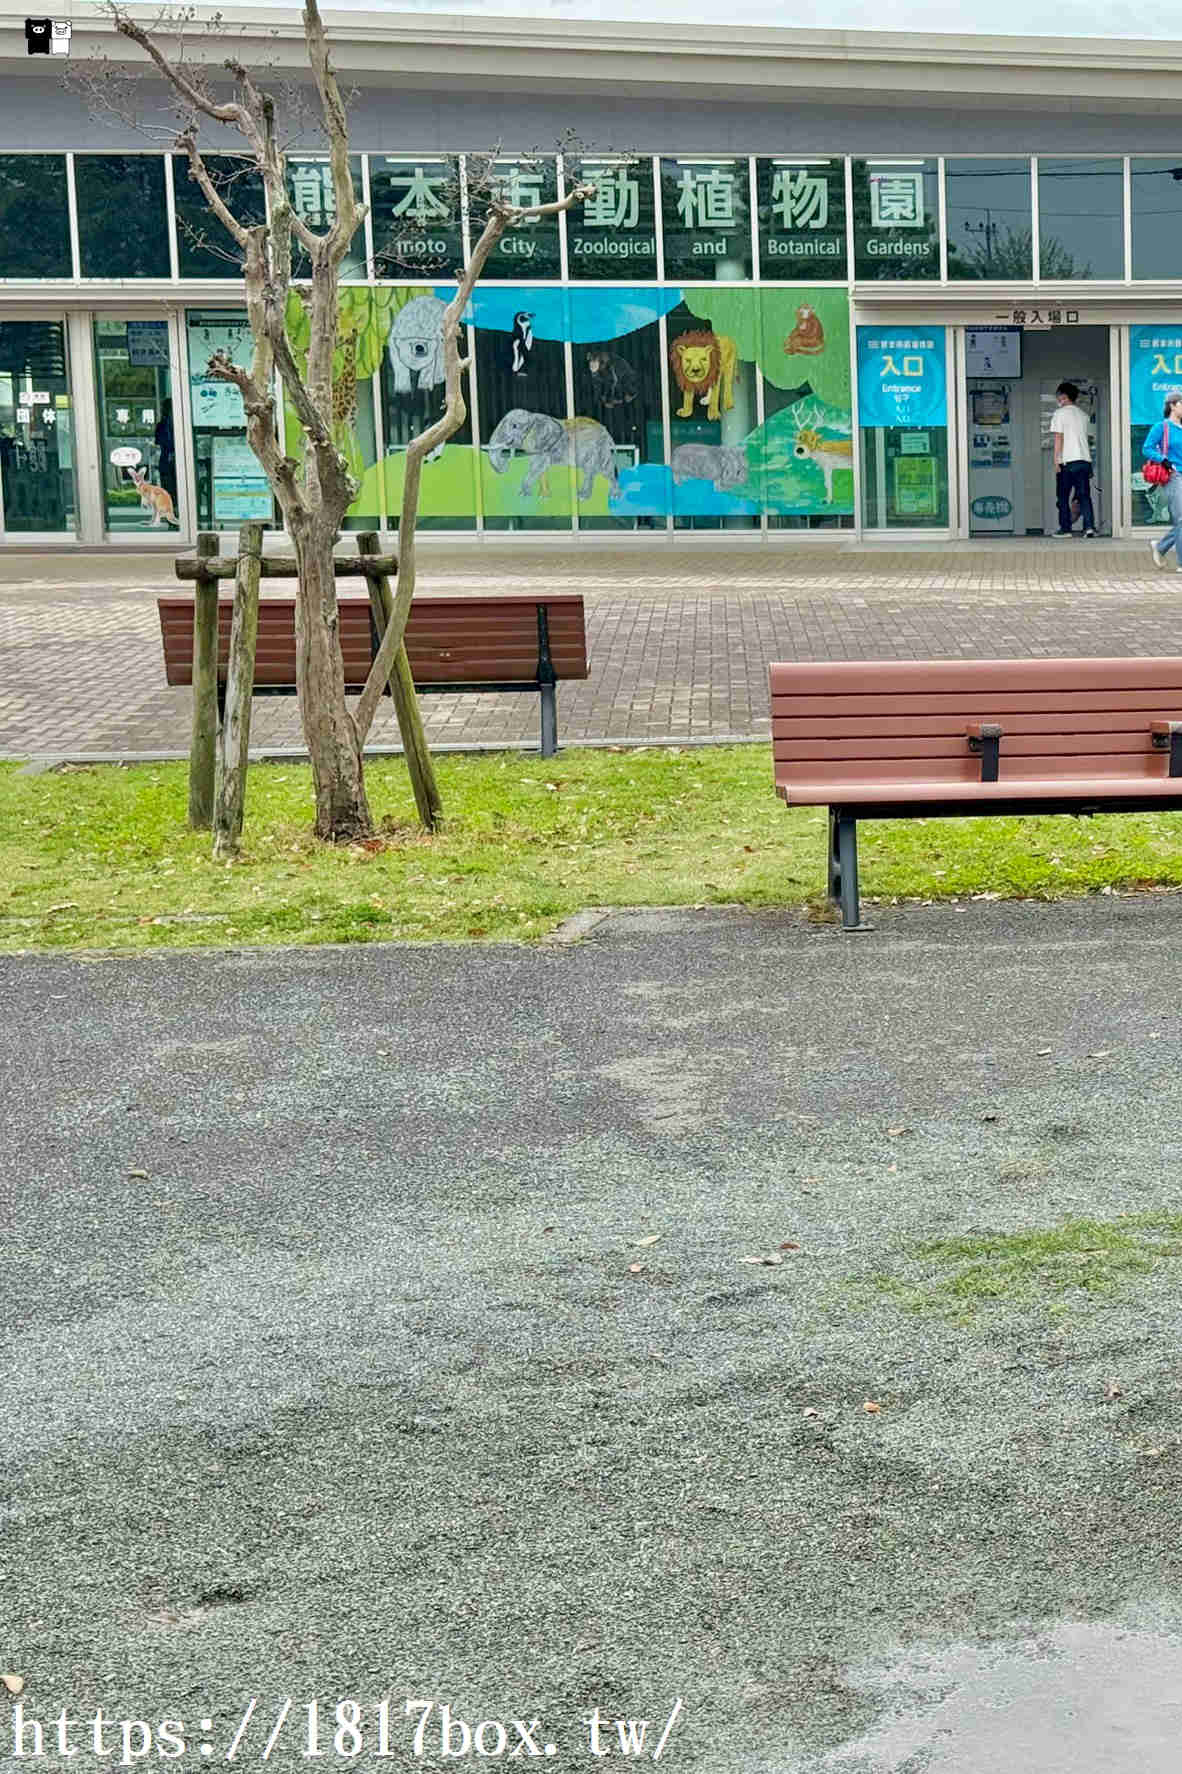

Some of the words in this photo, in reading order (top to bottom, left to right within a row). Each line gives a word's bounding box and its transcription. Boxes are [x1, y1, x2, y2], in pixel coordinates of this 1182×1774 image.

[500, 237, 536, 257] City
[574, 237, 656, 258] Zoological
[692, 238, 727, 255] and
[768, 239, 841, 255] Botanical
[867, 239, 930, 256] Gardens
[995, 310, 1079, 324] 一般入場口
[880, 355, 923, 376] 入口
